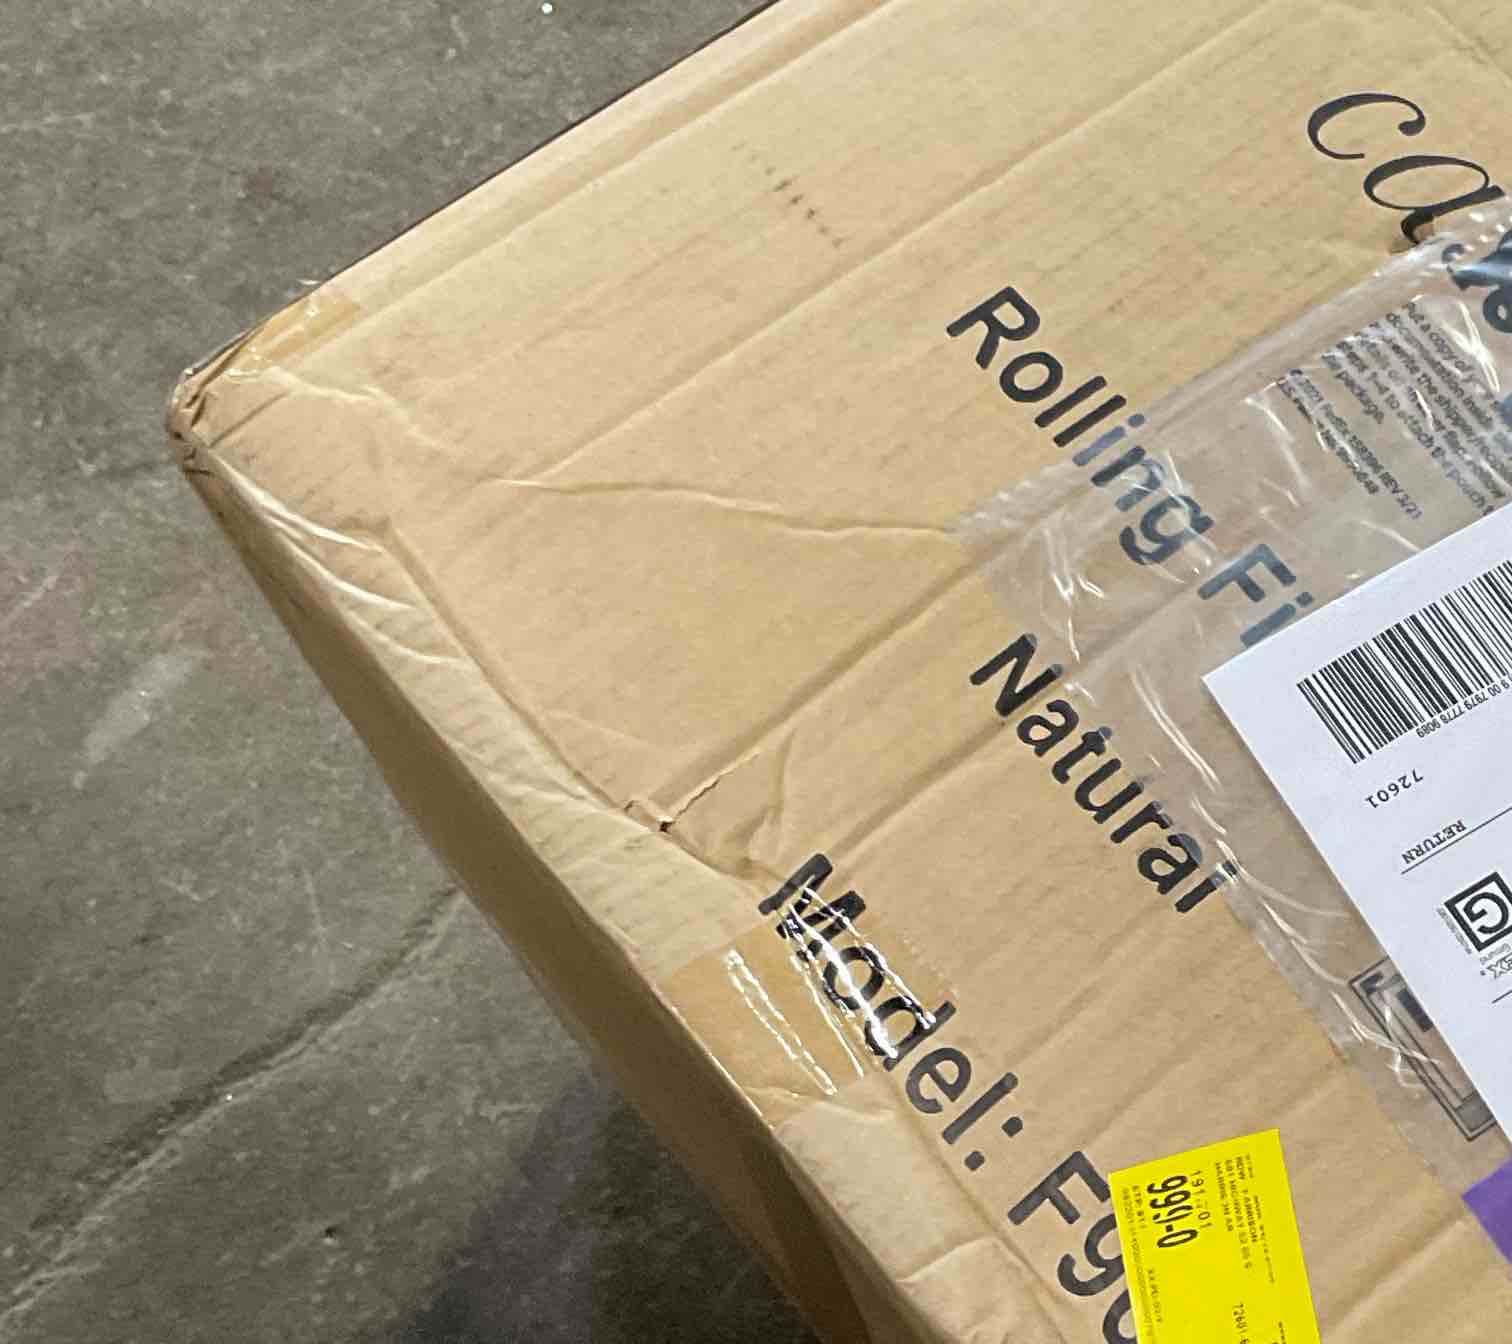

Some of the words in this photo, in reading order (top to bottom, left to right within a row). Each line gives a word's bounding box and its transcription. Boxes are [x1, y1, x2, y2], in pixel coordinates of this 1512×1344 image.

[946, 285, 1214, 565] Rolling
[1461, 690, 1488, 712] 7979
[1486, 682, 1502, 698] 00
[1414, 717, 1441, 739] 9089
[1438, 703, 1465, 725] 7778
[969, 634, 1239, 914] Natural
[1363, 767, 1423, 810] 72601
[1398, 817, 1467, 865] RETURN
[758, 852, 1024, 1172] Model:
